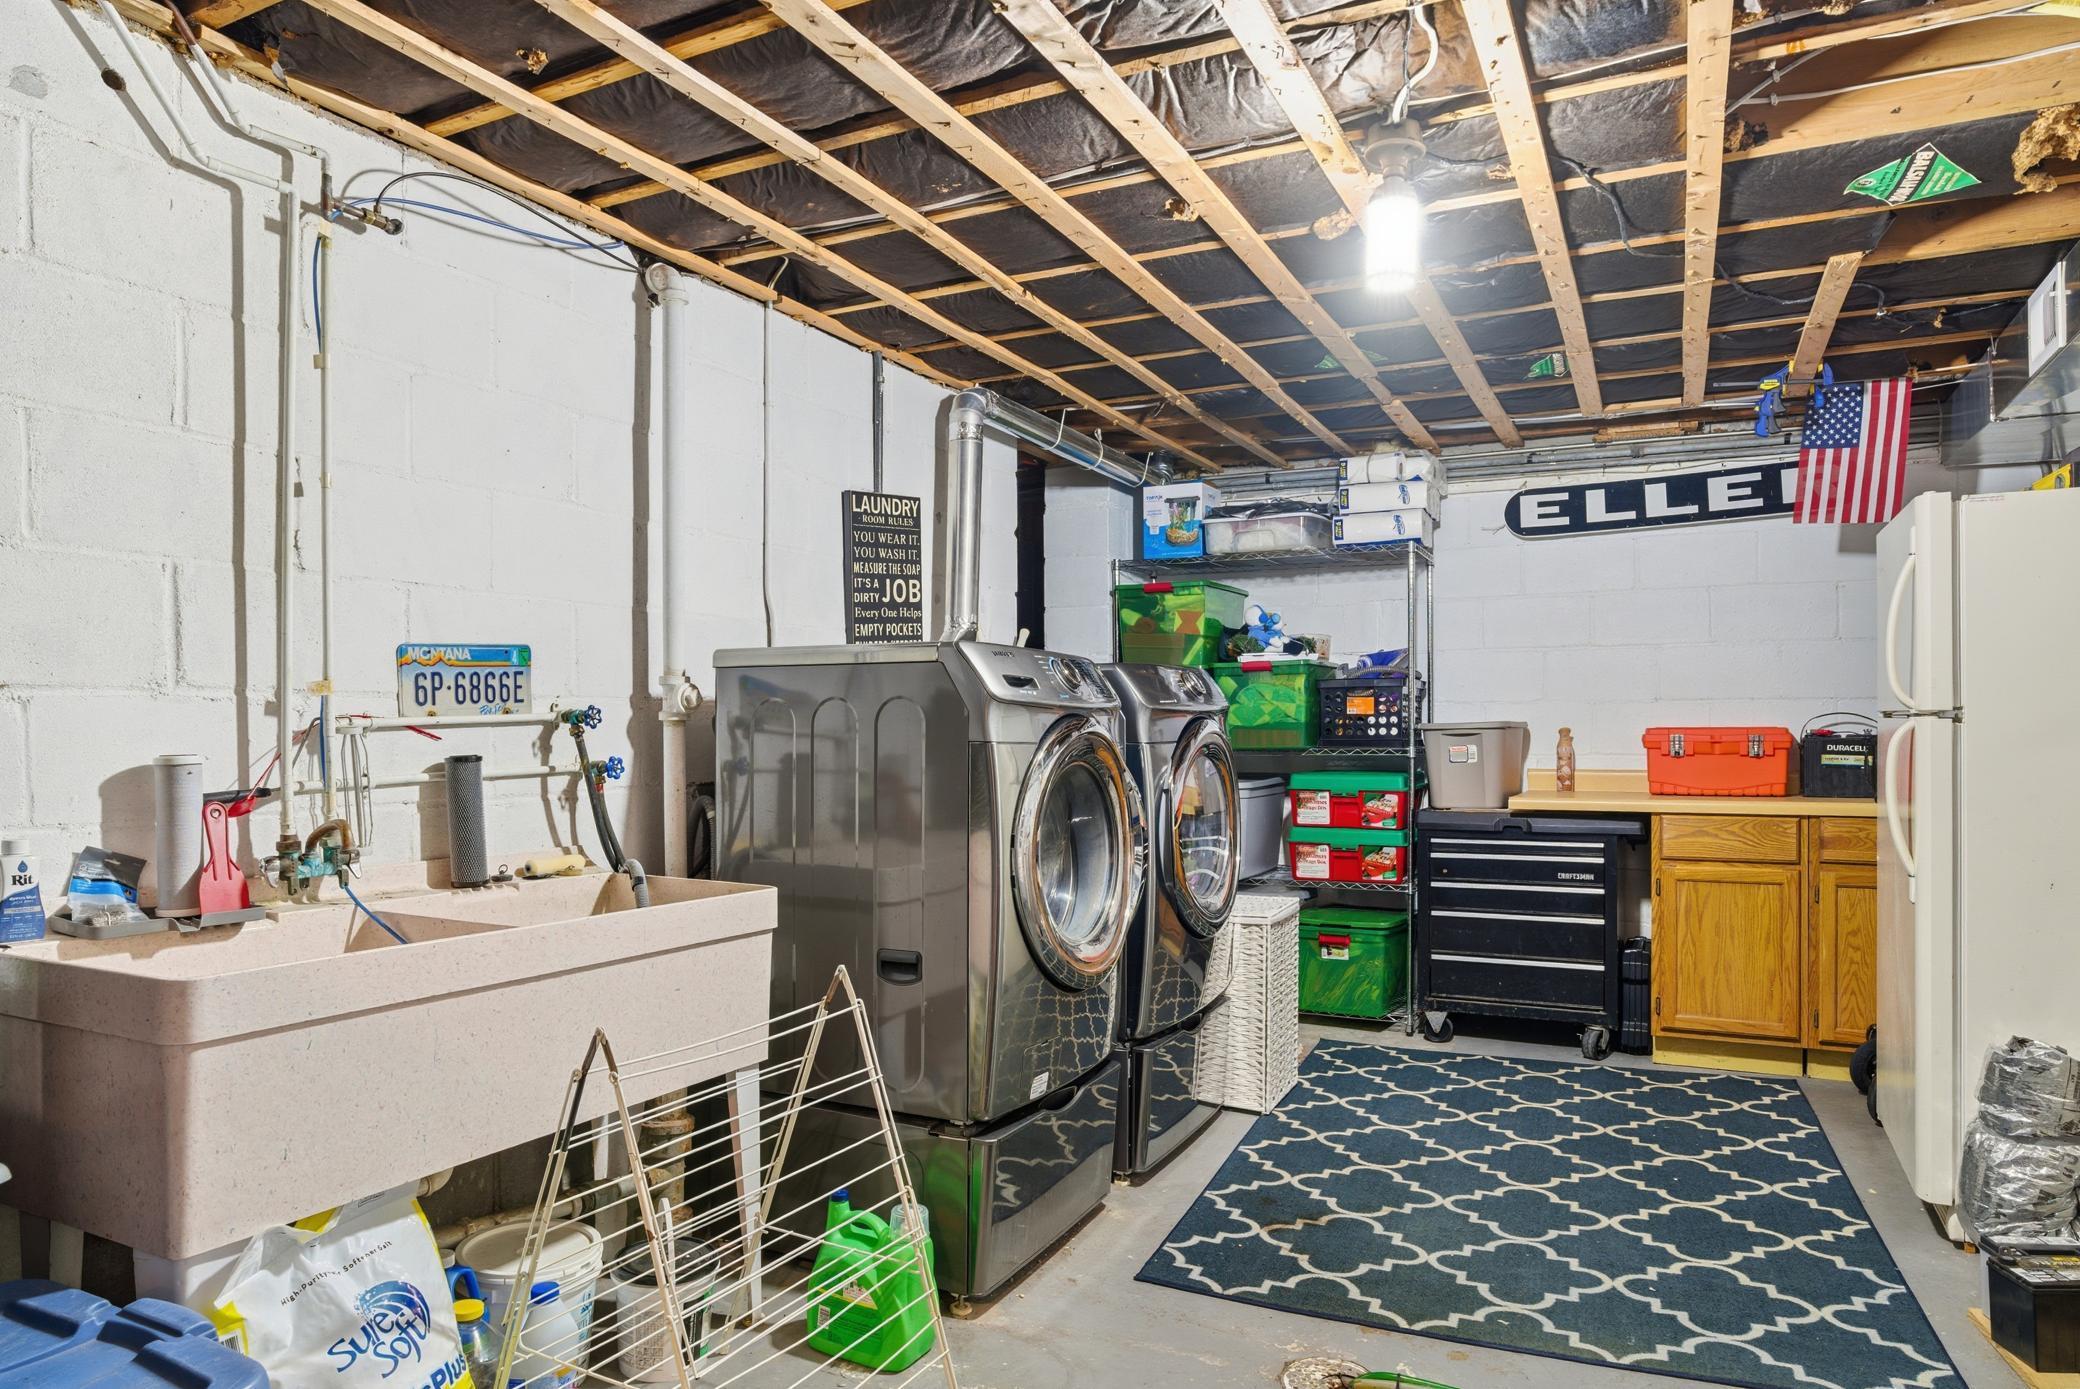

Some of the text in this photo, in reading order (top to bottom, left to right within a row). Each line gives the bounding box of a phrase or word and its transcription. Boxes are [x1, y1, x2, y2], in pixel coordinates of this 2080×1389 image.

[852, 494, 919, 517] LAUNDRY
[862, 514, 913, 527] ROOM RULES
[854, 531, 920, 546] YOU WEAR IT.
[854, 546, 920, 561] YOU WASH IT.
[853, 561, 921, 575] MEASURE THE SOAP
[854, 577, 879, 589] IT'S A
[854, 592, 879, 603] DIRTY
[882, 578, 921, 603] JOB
[855, 607, 922, 620] Every One Helps
[855, 623, 922, 637] EMPTY POCKETS
[407, 647, 472, 660] MONTANA
[11, 874, 33, 886] Rit
[327, 1312, 395, 1373] Sure
[373, 1312, 428, 1378] Soft
